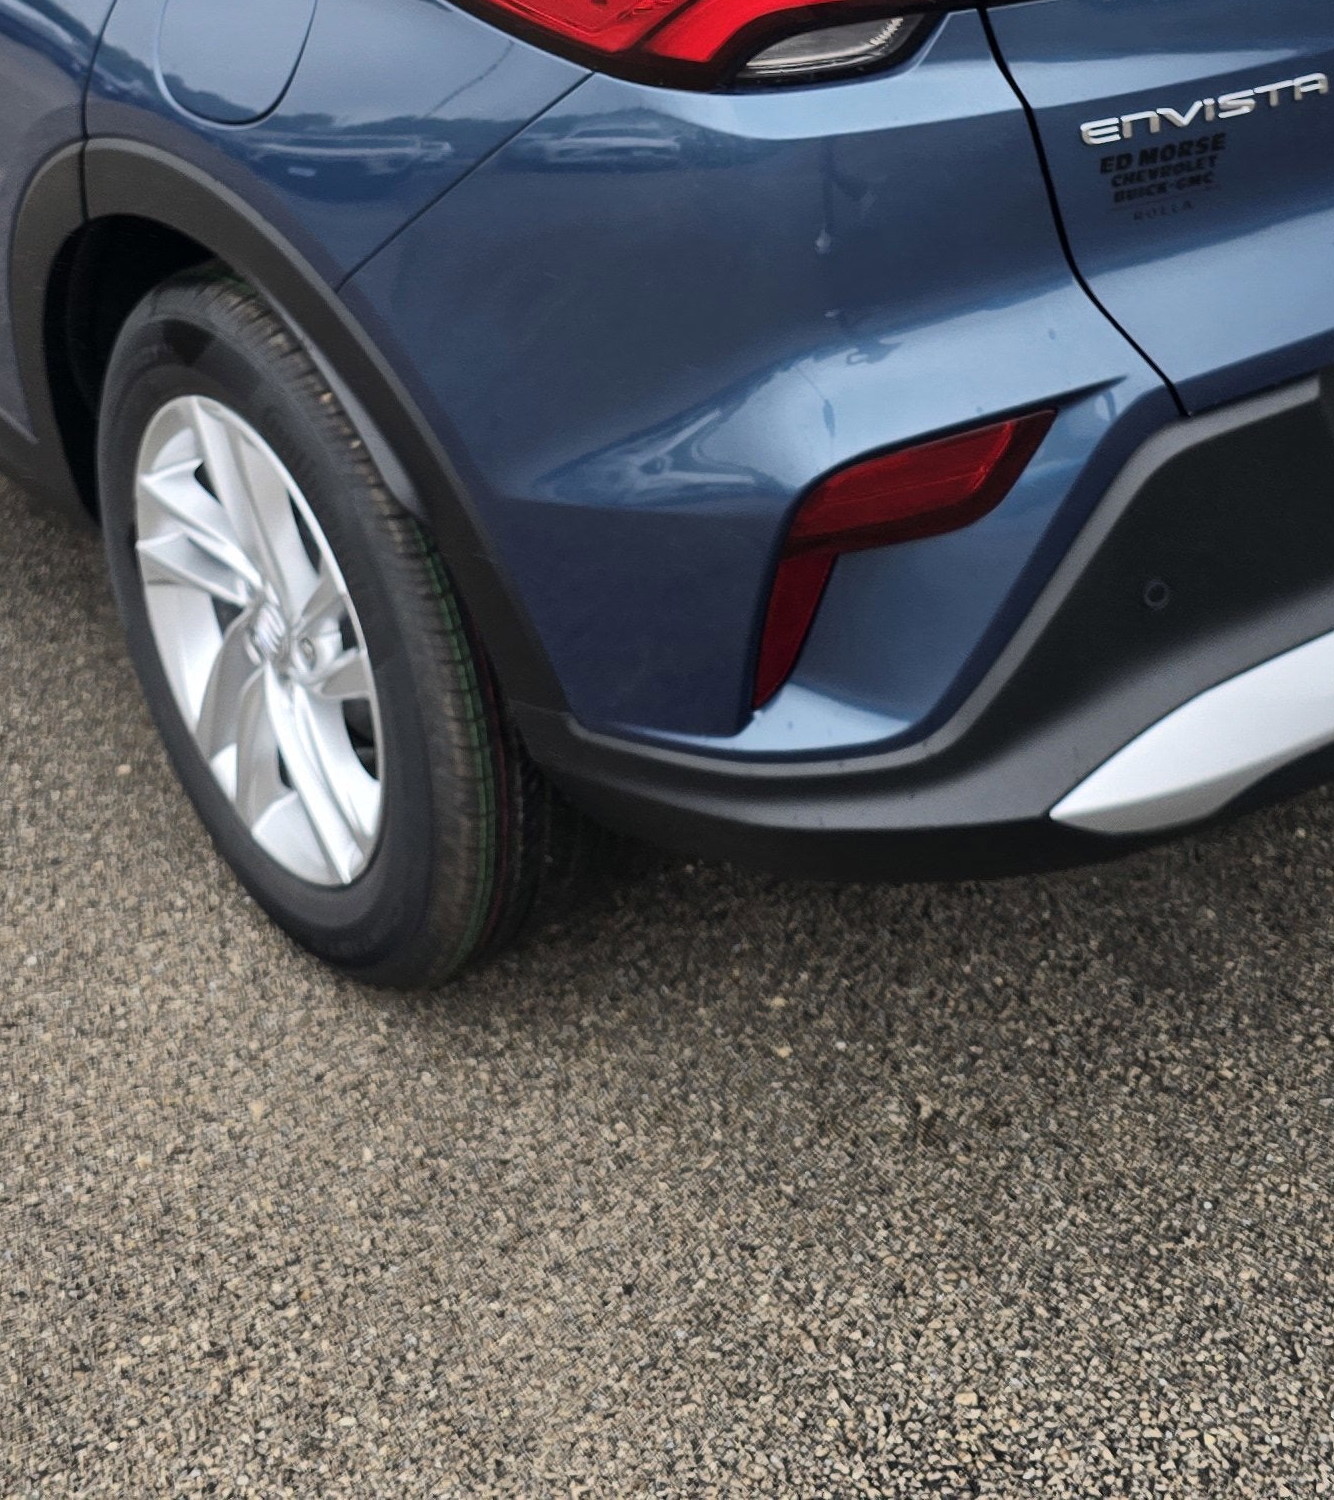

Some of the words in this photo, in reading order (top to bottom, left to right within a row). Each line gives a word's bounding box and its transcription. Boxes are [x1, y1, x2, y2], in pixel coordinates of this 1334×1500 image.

[1079, 72, 1329, 145] ENVISTA
[1099, 154, 1134, 175] ED
[1138, 132, 1227, 167] MORSE
[1110, 156, 1217, 188] CHEVROLET
